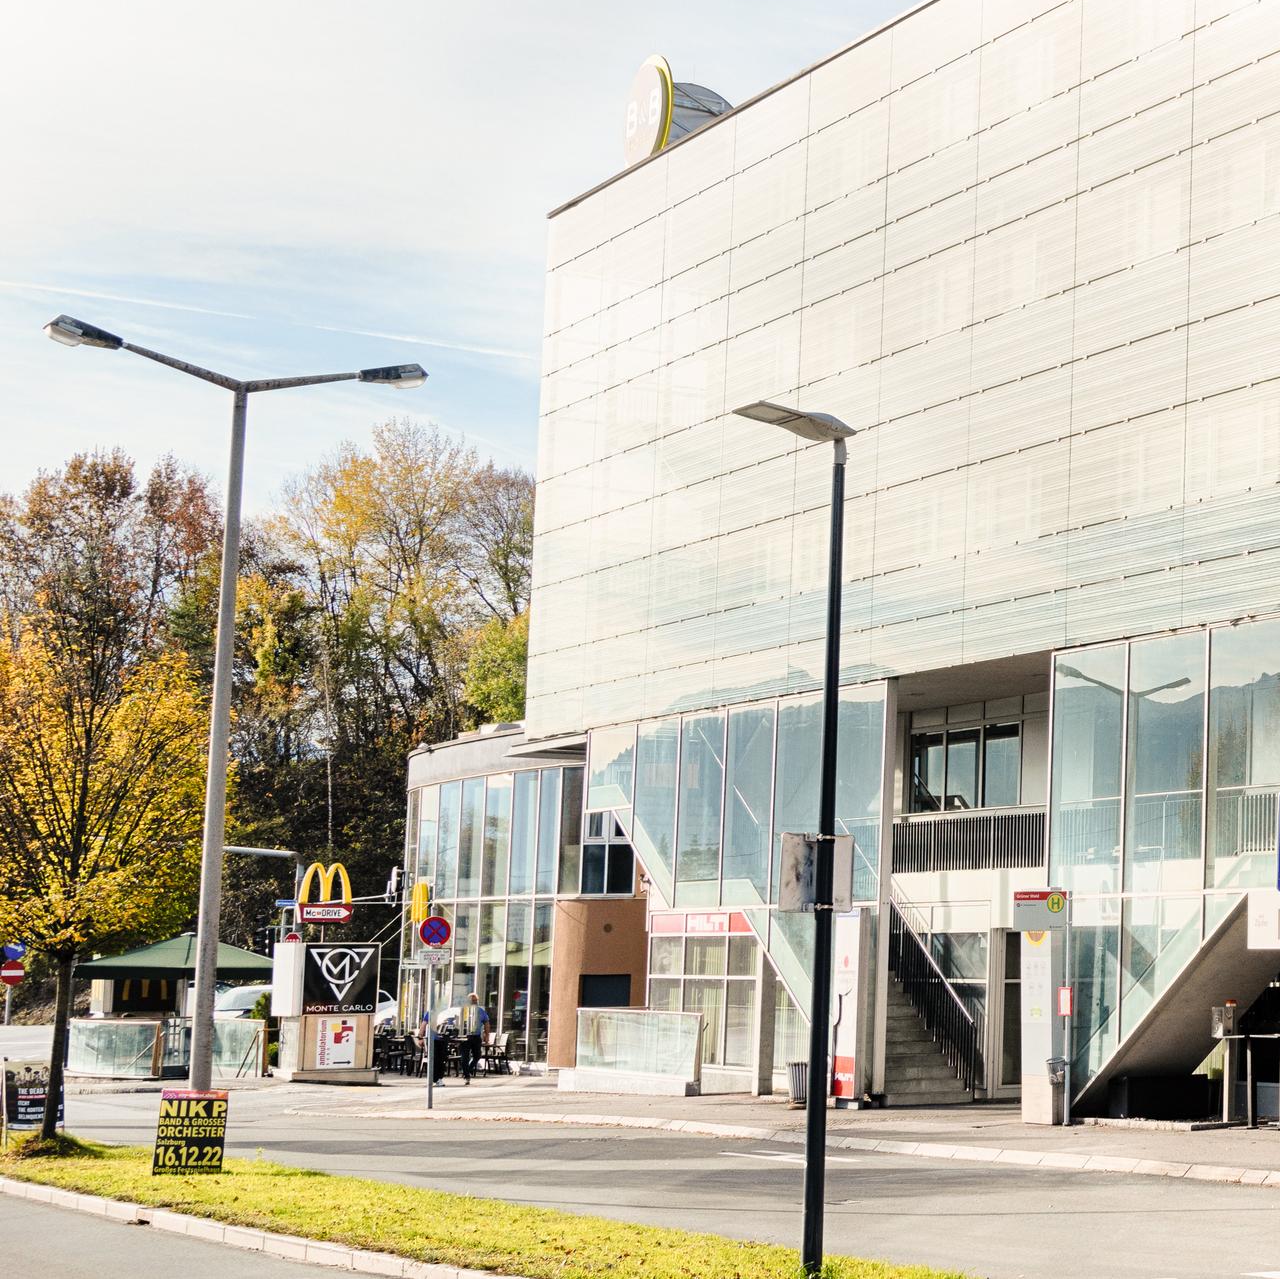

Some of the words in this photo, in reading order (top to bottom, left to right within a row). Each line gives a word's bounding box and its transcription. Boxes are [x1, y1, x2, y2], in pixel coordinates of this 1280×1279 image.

[321, 909, 343, 917] DRIVE
[341, 1004, 374, 1012] CARLO
[319, 1019, 328, 1066] ambulatorium
[160, 1100, 208, 1117] NIK
[211, 1100, 228, 1118] P.
[159, 1117, 182, 1125] BAND
[183, 1117, 190, 1125] &
[191, 1118, 226, 1126] GROSSES
[158, 1126, 225, 1138] ORCHESTER
[157, 1138, 186, 1147] Salzburg
[156, 1146, 222, 1167] 16.12.22
